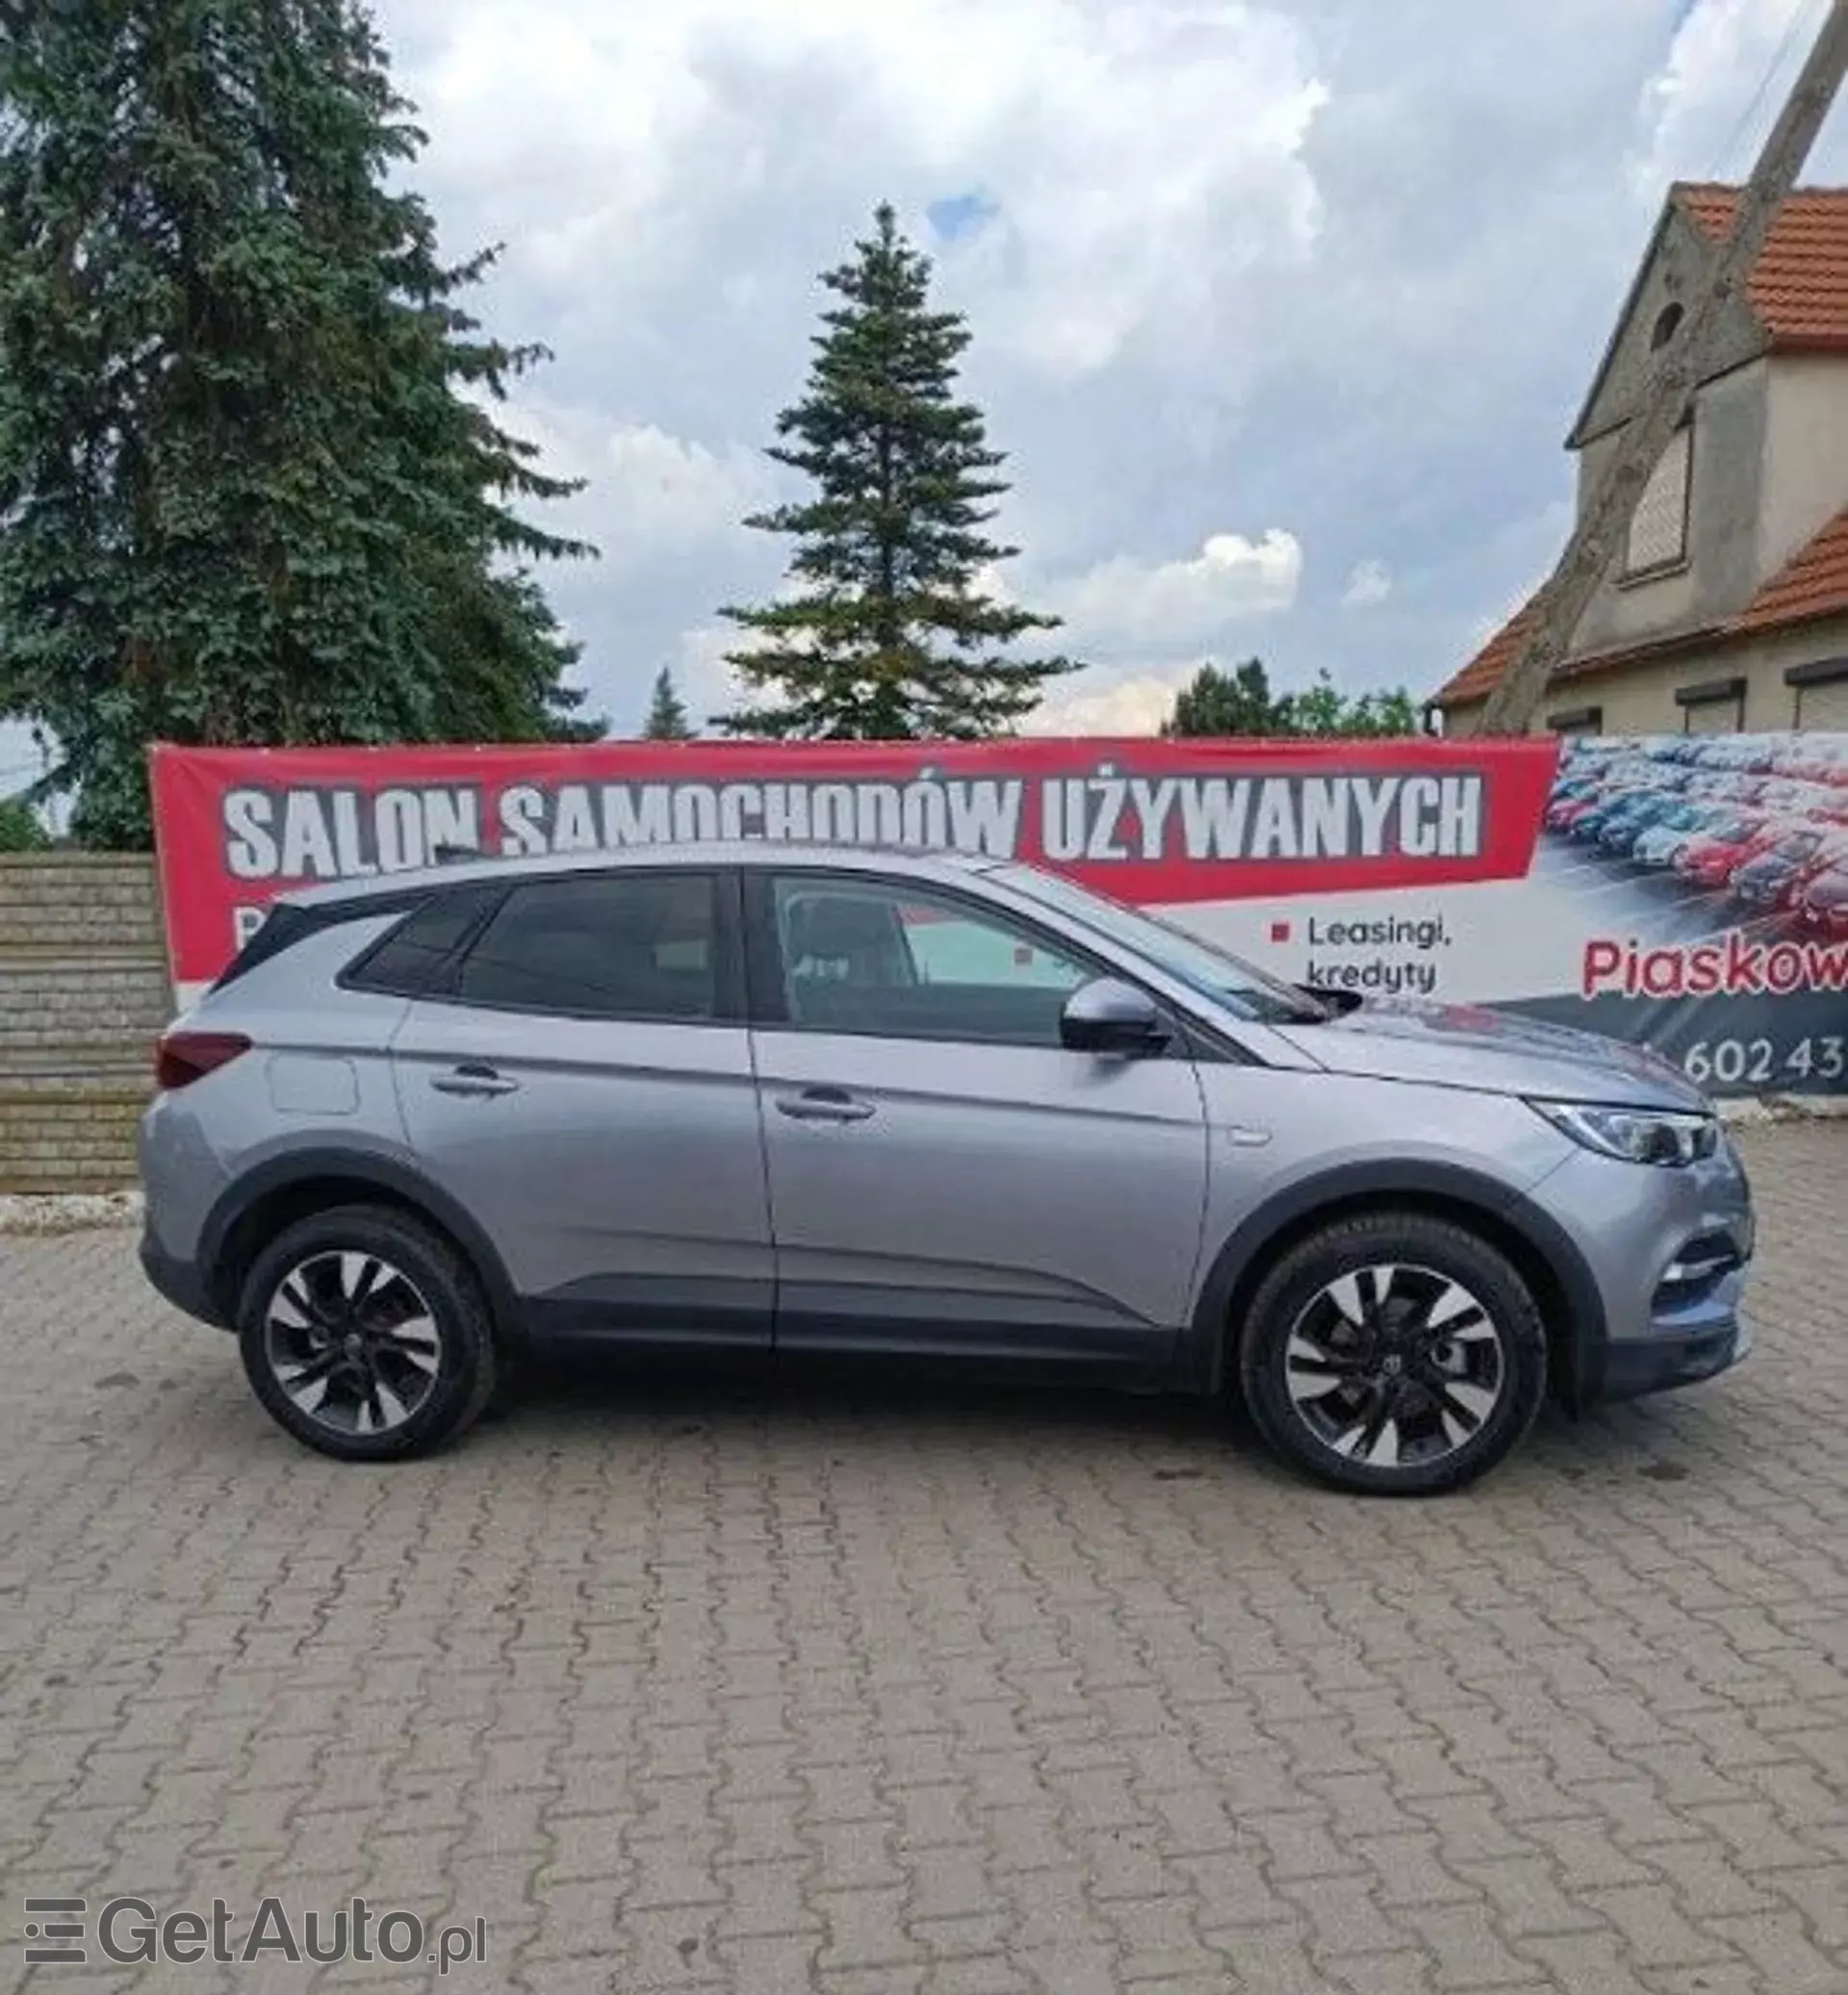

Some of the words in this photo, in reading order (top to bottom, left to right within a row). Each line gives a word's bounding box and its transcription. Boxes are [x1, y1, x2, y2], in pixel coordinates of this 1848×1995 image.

[223, 786, 480, 877] SALON
[499, 768, 1023, 857] SAMOCHODÓW
[1042, 763, 1482, 861] UŻYWANYCH
[1308, 913, 1451, 949] Leasingi,
[1308, 958, 1436, 994] kredyty
[1582, 927, 1848, 996] Piaskow
[1684, 1038, 1773, 1083] 602
[1785, 1036, 1844, 1079] 43
